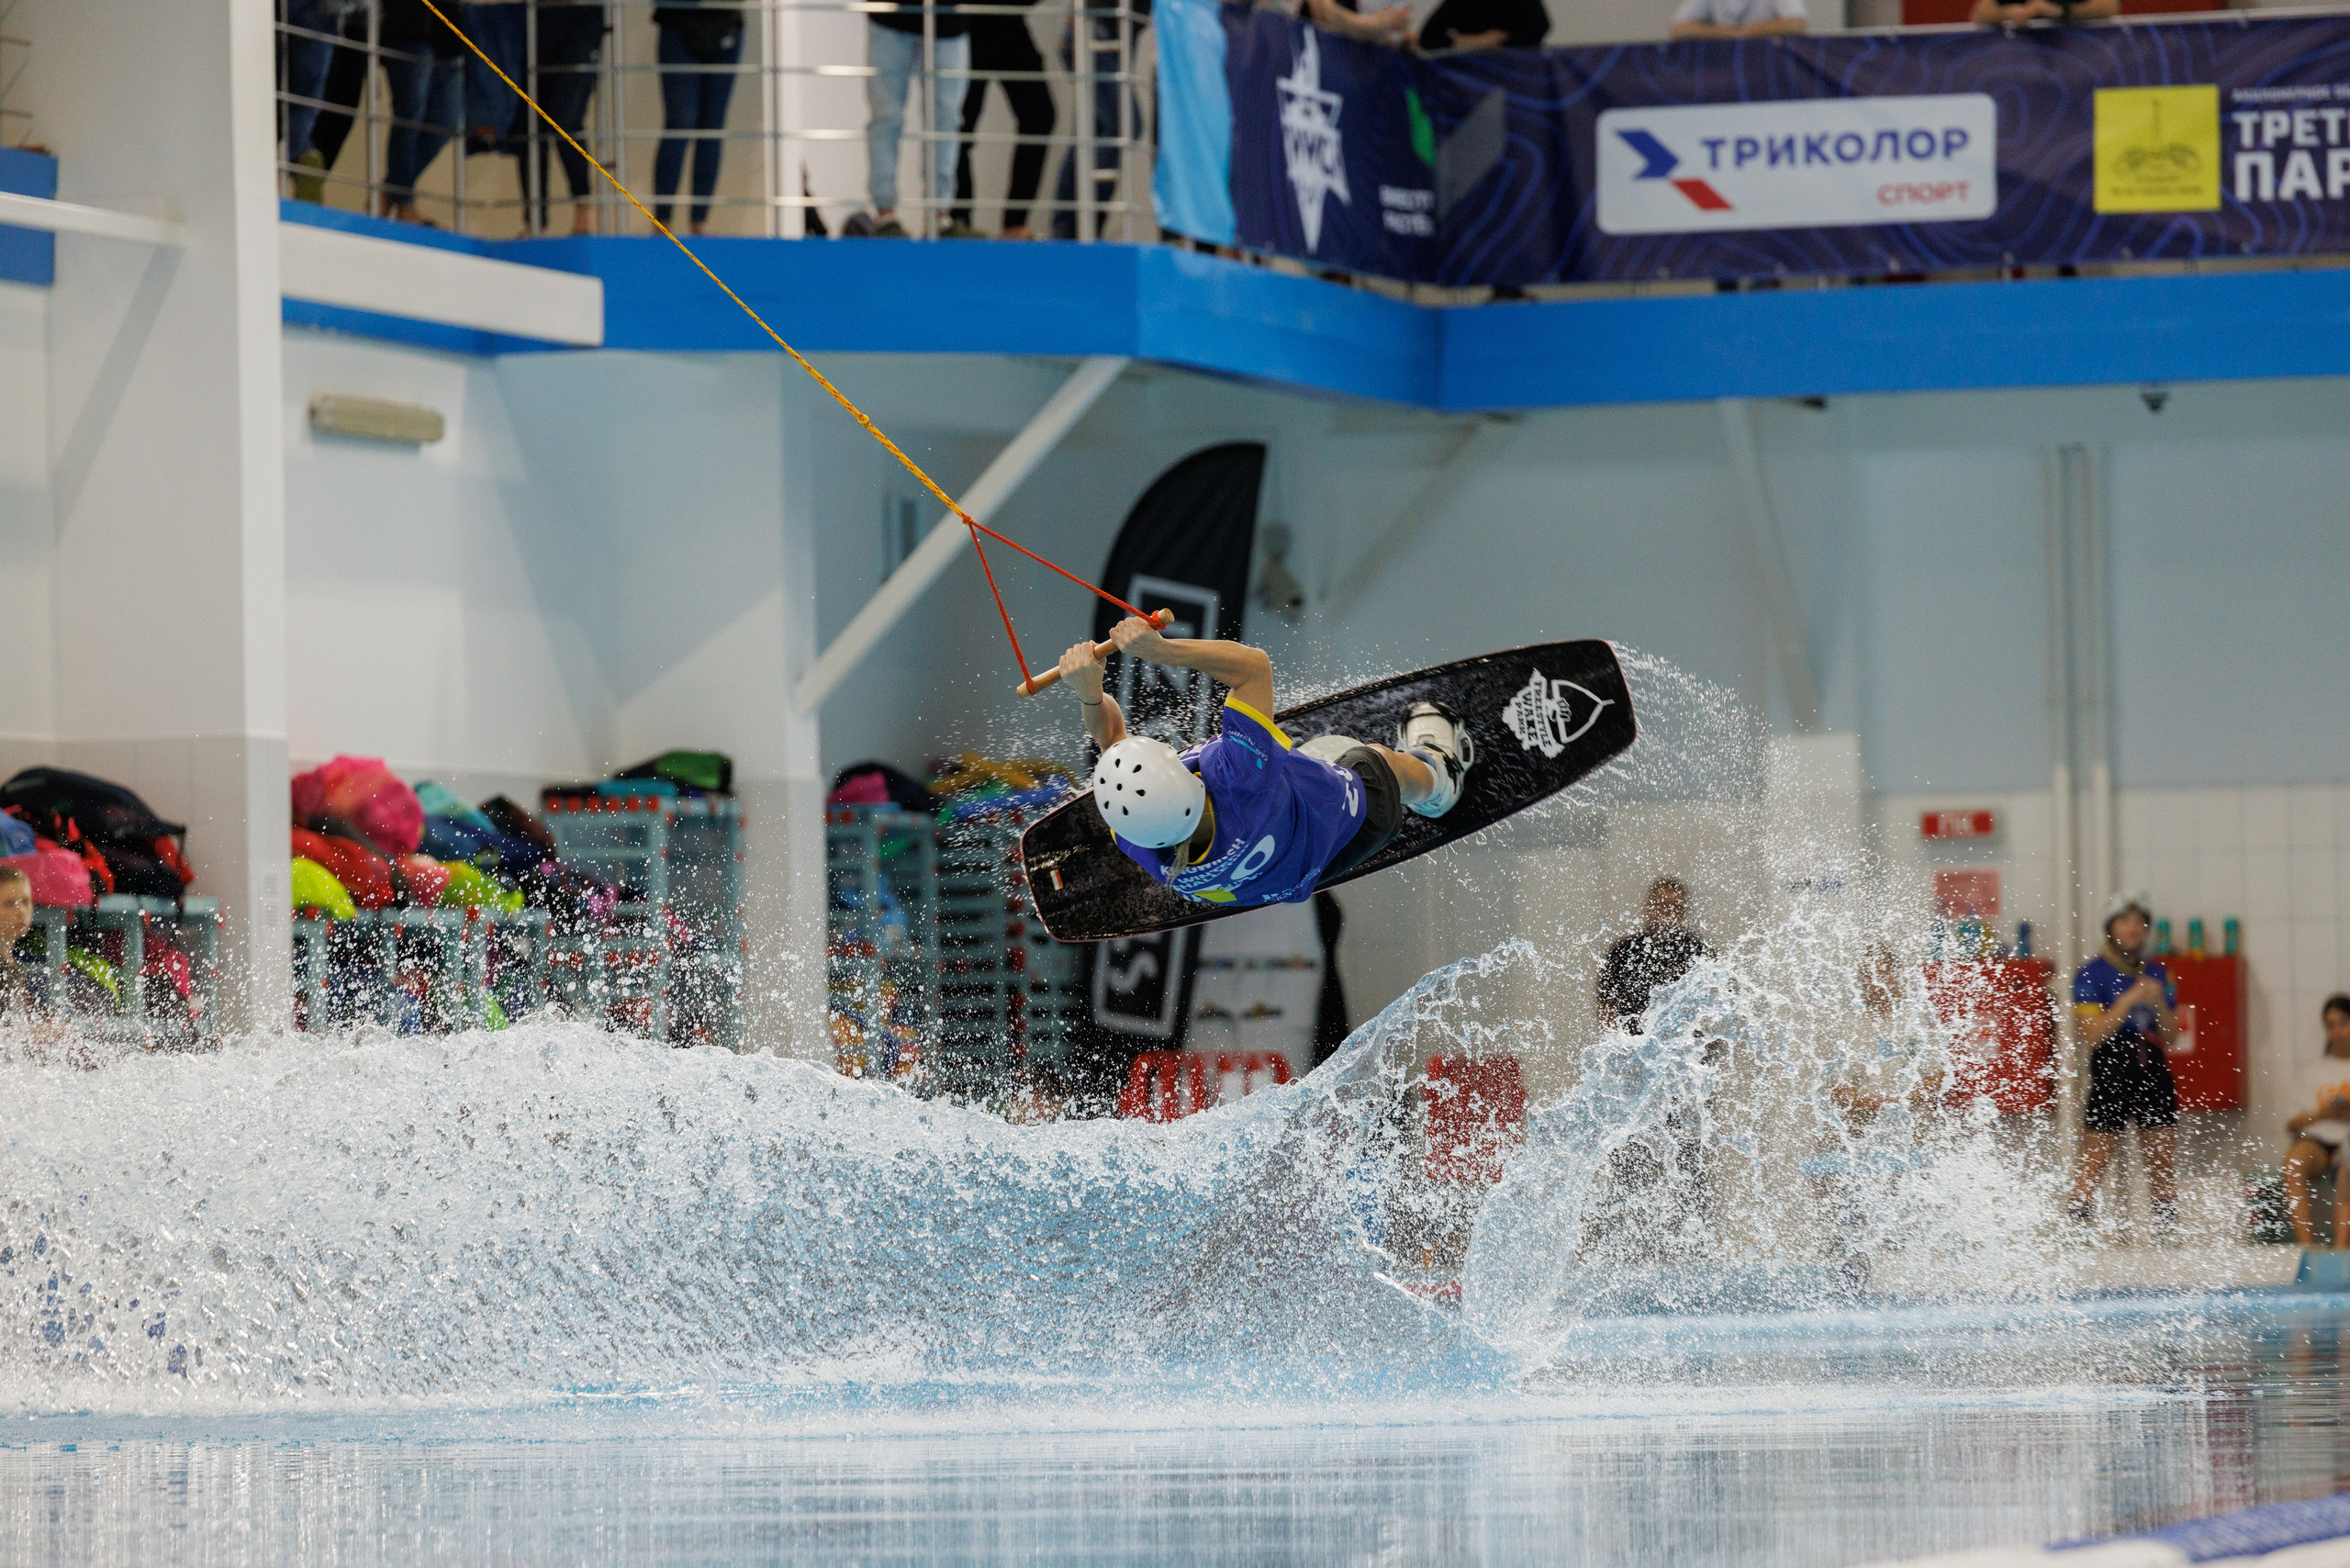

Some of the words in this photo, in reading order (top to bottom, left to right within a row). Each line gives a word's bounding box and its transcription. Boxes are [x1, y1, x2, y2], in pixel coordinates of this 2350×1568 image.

[1700, 127, 1971, 171] ТРИКОЛОР
[2232, 108, 2350, 150] ТРЕТ
[1876, 181, 1971, 207] СПОРТ
[2234, 149, 2350, 202] ПАР
